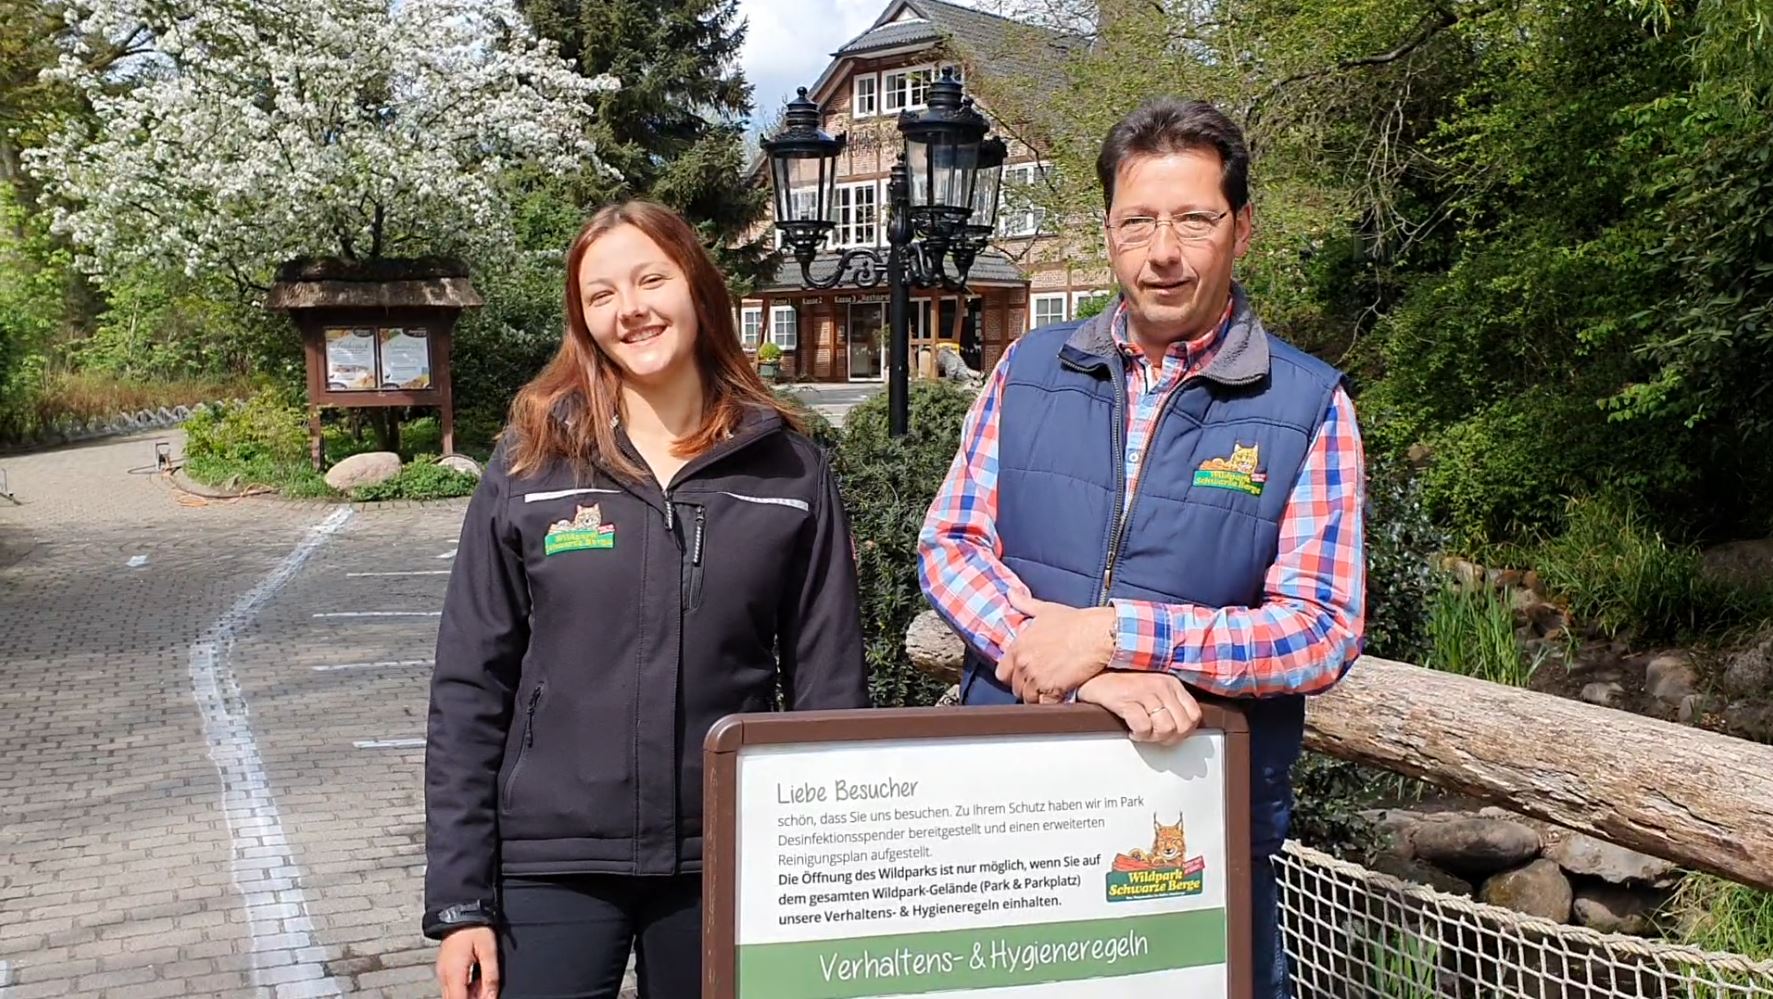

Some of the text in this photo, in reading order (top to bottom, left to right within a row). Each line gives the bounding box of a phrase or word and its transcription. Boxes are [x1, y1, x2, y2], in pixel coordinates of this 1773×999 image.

[777, 777, 919, 804] Liebe Besucher
[778, 795, 1145, 827] schön, dass Sie uns besuchen. Zu Ihrem Schutz haben wir im Park
[778, 817, 1105, 847] Desinfektionsspender bereitgestellt und einen erweiterten
[778, 846, 933, 868] Reinigungsplan aufgestellt.
[778, 853, 1102, 886] Die Öffnung des Wildparks ist nur möglich, wenn Sie auf
[779, 874, 1081, 907] dem gesamten Wildpark-Gelände (Park & Parkplatz)
[1108, 882, 1167, 896] Schwarze
[1168, 880, 1201, 892] Berge
[1128, 869, 1183, 884] Wildpark
[779, 896, 1062, 925] unsere Verhaltens- & Hygieneregeln einhalten.
[819, 929, 1149, 982] Verhaltens- & Hygieneregeln
